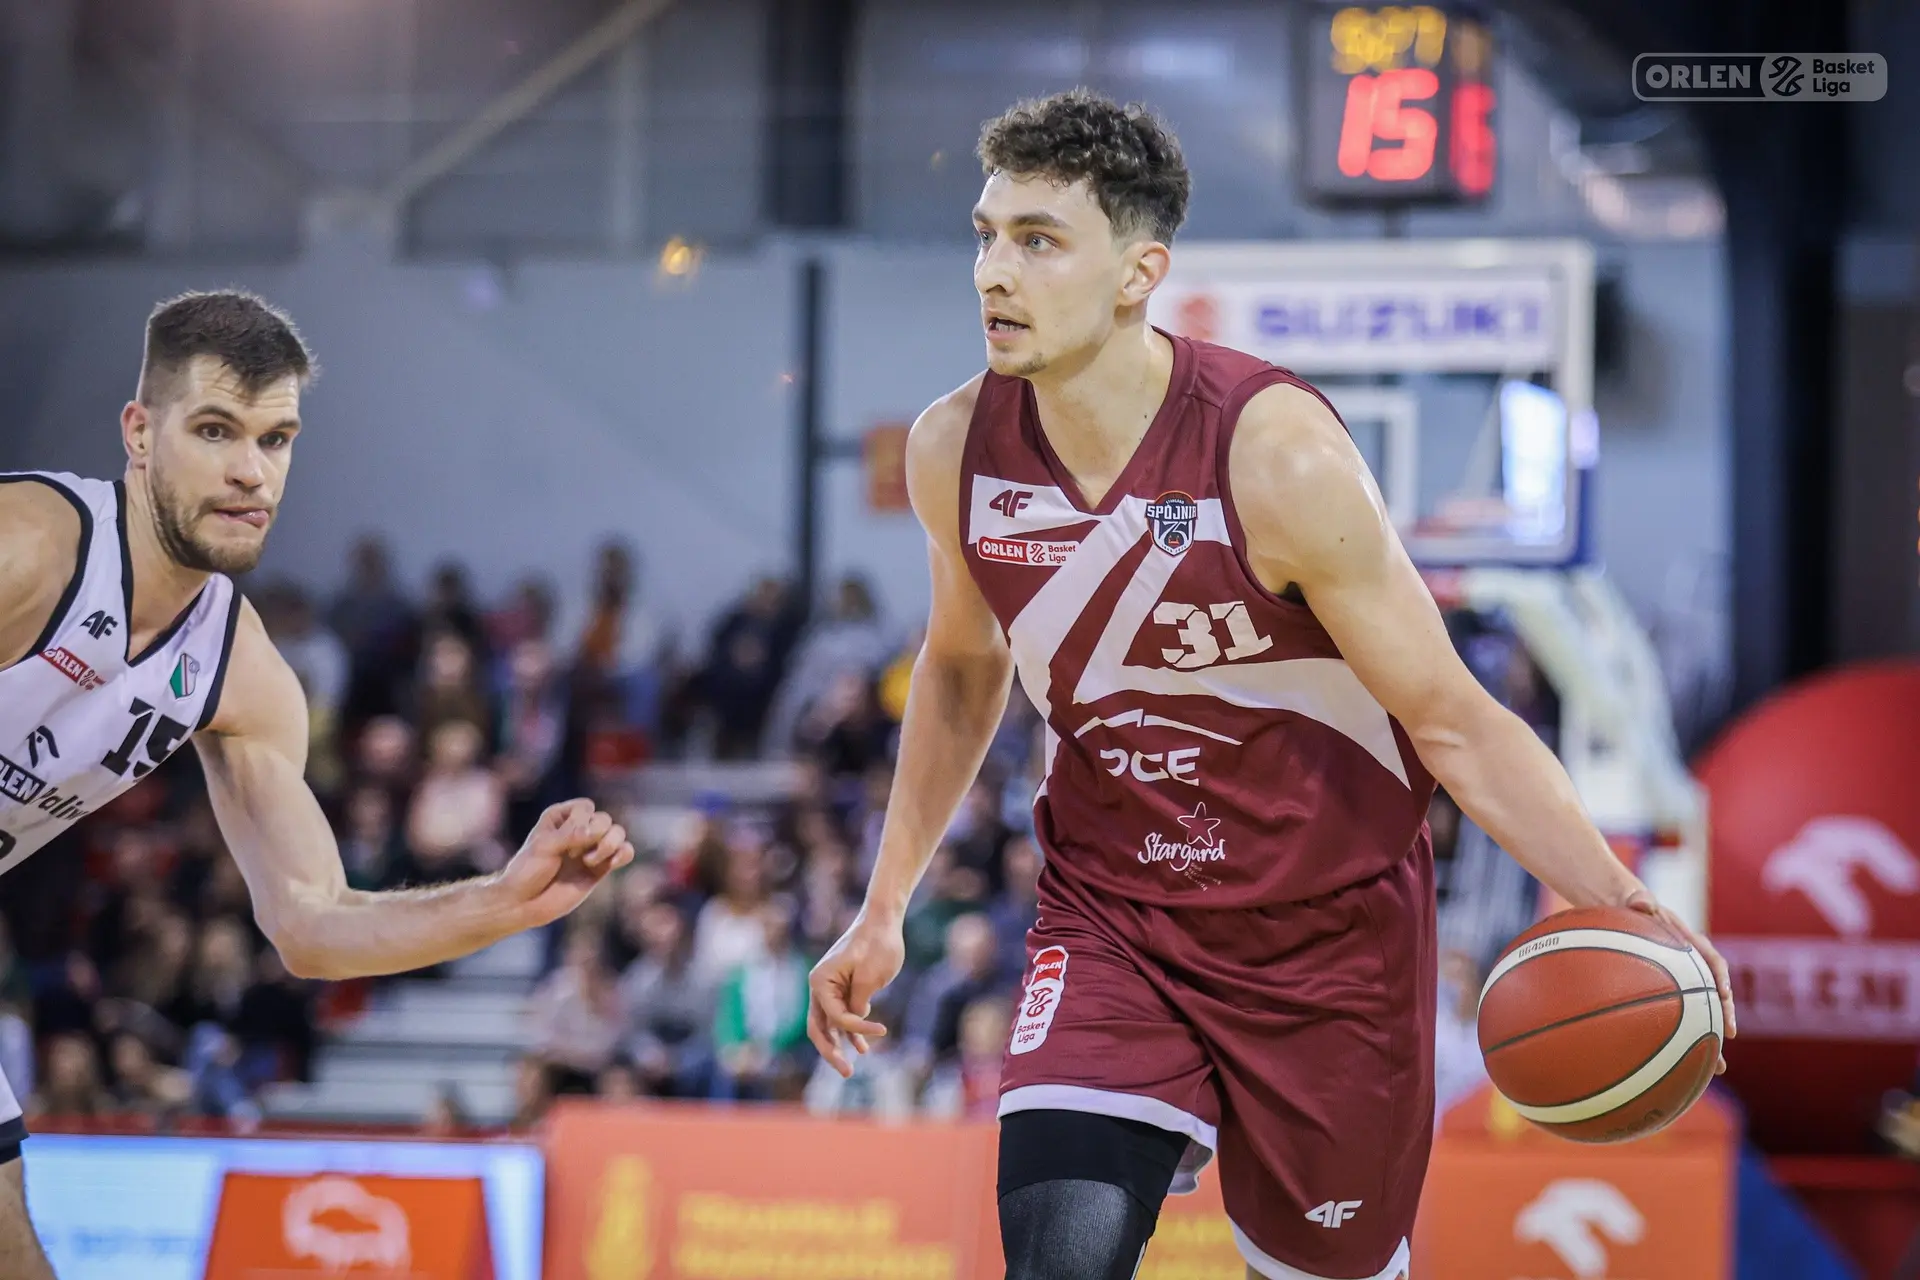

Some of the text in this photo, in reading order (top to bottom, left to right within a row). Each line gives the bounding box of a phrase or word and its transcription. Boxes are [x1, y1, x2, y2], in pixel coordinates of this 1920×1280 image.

[1338, 68, 1439, 181] 15
[989, 489, 1034, 518] 4F
[982, 541, 1076, 558] ORLEN Basket
[1049, 554, 1067, 563] Liga
[80, 610, 118, 640] 4F
[1153, 601, 1274, 669] 31
[44, 649, 84, 678] ORLEN
[0, 760, 40, 801] LEN
[1137, 832, 1226, 872] Stargard
[1017, 1021, 1045, 1034] Basket
[1018, 1033, 1035, 1044] Liga
[1305, 1200, 1363, 1228] 4F
